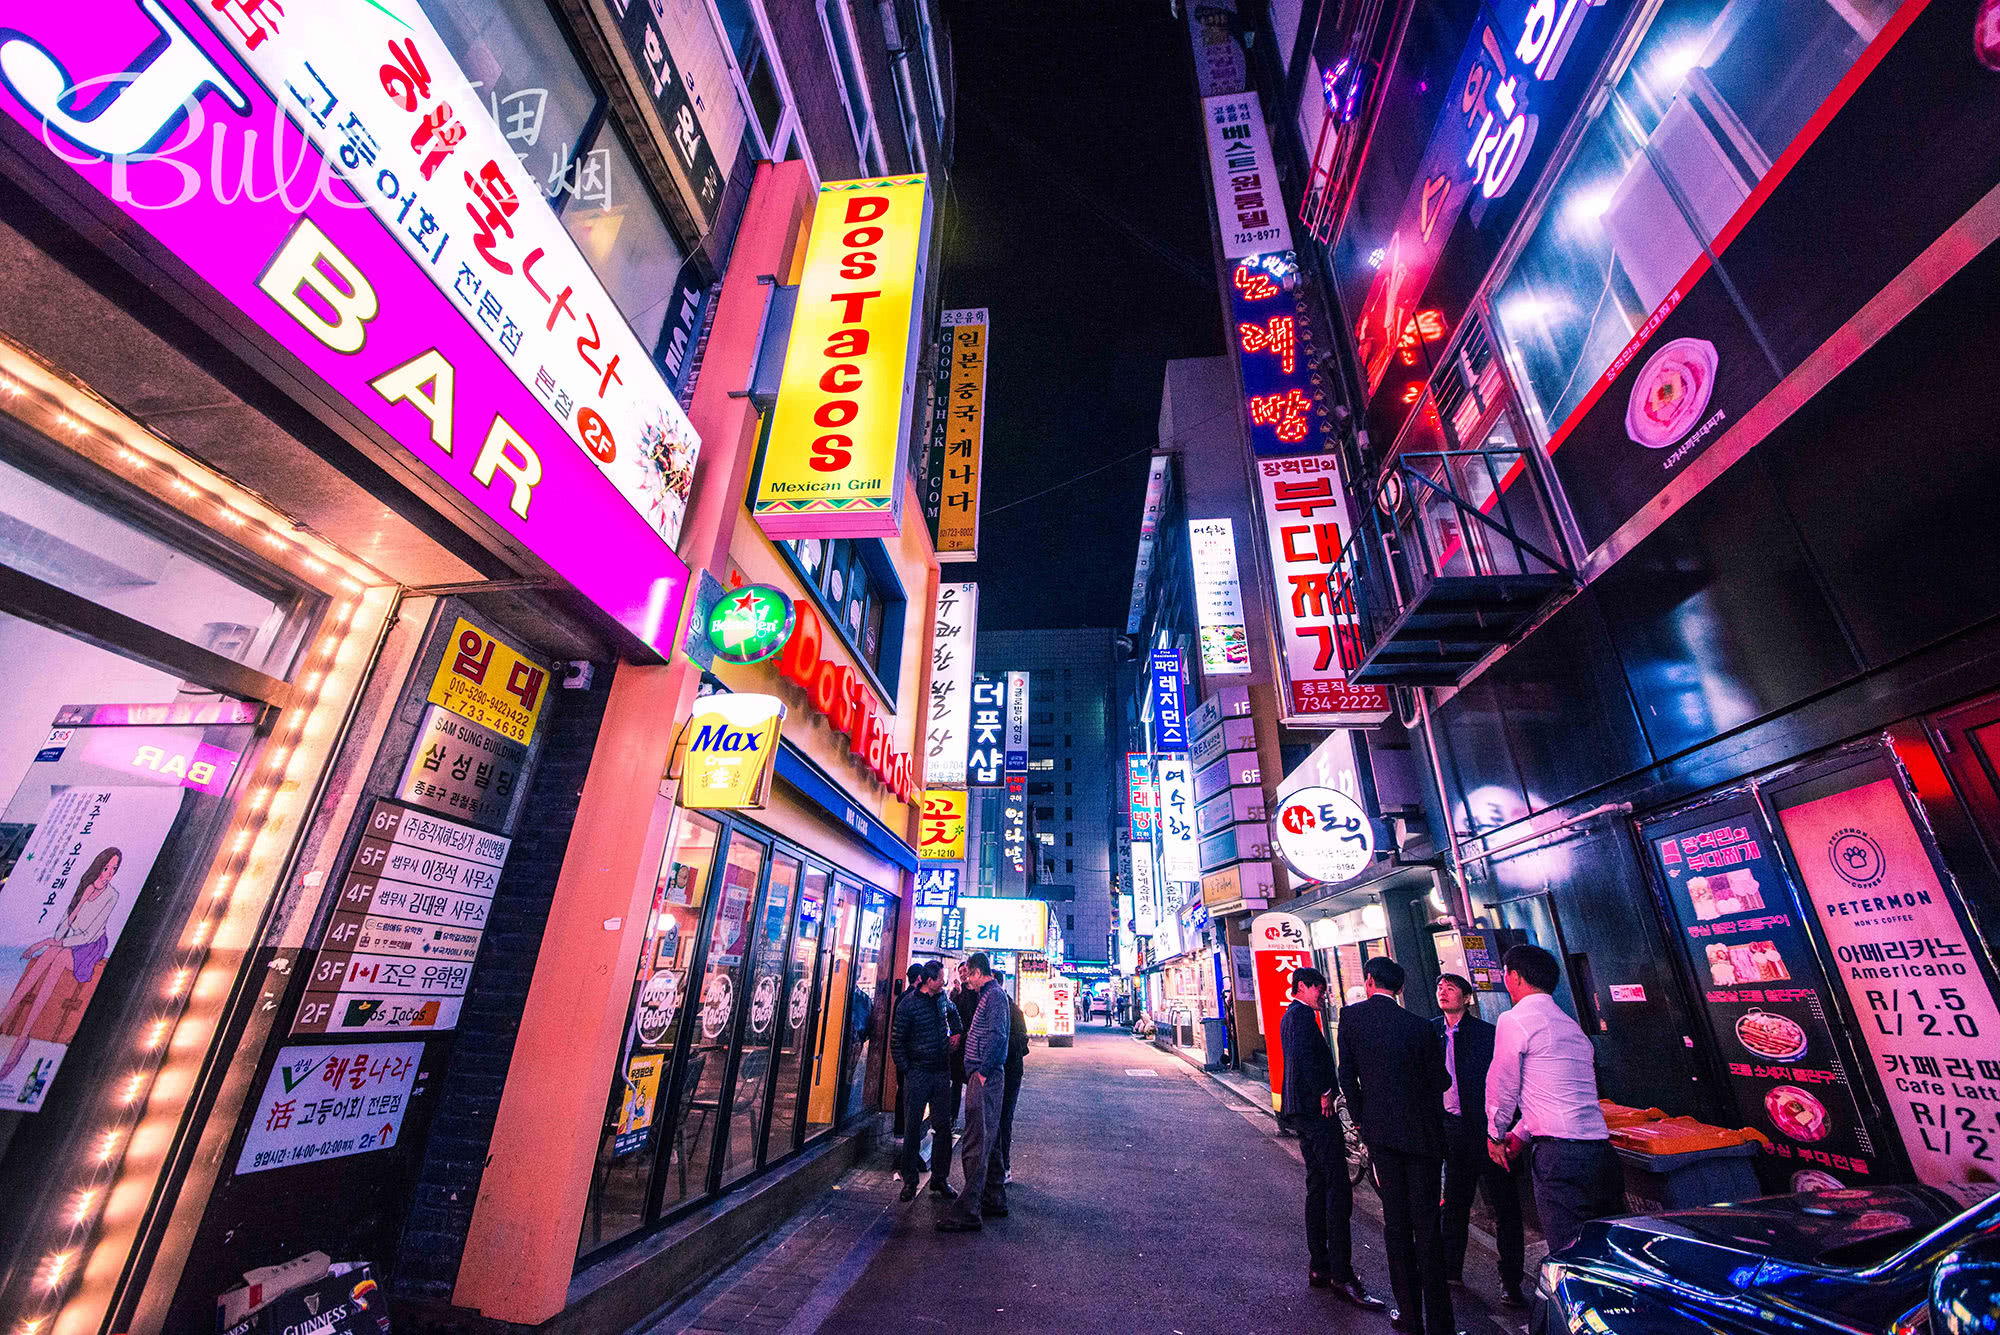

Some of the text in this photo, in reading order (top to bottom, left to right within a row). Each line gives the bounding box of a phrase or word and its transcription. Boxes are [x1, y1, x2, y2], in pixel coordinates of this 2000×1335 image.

[284, 60, 524, 357] 고등어회 전문점
[378, 36, 624, 398] 해물나라
[1234, 228, 1281, 243] 723-8977
[1639, 290, 1682, 340] 부대찌개
[809, 196, 890, 472] Dos Tacos
[254, 213, 544, 522] BAR
[938, 332, 953, 381] GOOD
[536, 364, 574, 419] 본점
[583, 413, 612, 460] 2F
[1262, 457, 1336, 476] 장혁민의
[770, 477, 882, 492] Mexican Grill
[948, 539, 964, 549] 3F
[962, 583, 975, 592] 5F
[1273, 477, 1366, 672] 부대찌개
[1154, 660, 1183, 744] 파인 레지던스
[1233, 701, 1250, 715] 1F
[1298, 694, 1384, 711] 734-2222
[435, 716, 522, 763] SAM SUNG BUILDING
[690, 724, 764, 752] Max
[1242, 769, 1261, 784] 6F
[414, 780, 448, 802] 종로구
[79, 793, 112, 835] 제주로
[374, 810, 399, 832] 6F
[1680, 826, 1751, 854] 장혁민의
[1828, 827, 1868, 846] PETERMON
[920, 848, 956, 859] 37-1210
[1251, 843, 1271, 859] 3F
[1686, 840, 1762, 872] 부대찌개
[360, 847, 495, 891] 5F 법무사 이정석 사무소
[1850, 876, 1883, 890] COFFEE
[37, 842, 84, 925] 오실래요?
[346, 883, 486, 922] 4F 법무사 김대원 사무소
[1826, 890, 1933, 918] PETERMON
[330, 924, 359, 945] 4F
[1853, 914, 1914, 928] MON'S COFFEE
[1837, 937, 1968, 964] 아메리카노
[316, 961, 466, 990] 3F 조은 유학원
[1850, 961, 1968, 981] Americano
[301, 1003, 329, 1024] 2F
[321, 1054, 413, 1091] 해물나라
[1895, 1076, 1946, 1097] Cafe
[296, 1094, 363, 1127] 고등어회
[366, 1093, 402, 1119] 전문점
[358, 1133, 378, 1150] 2F
[283, 1304, 349, 1335] GUINNESS
